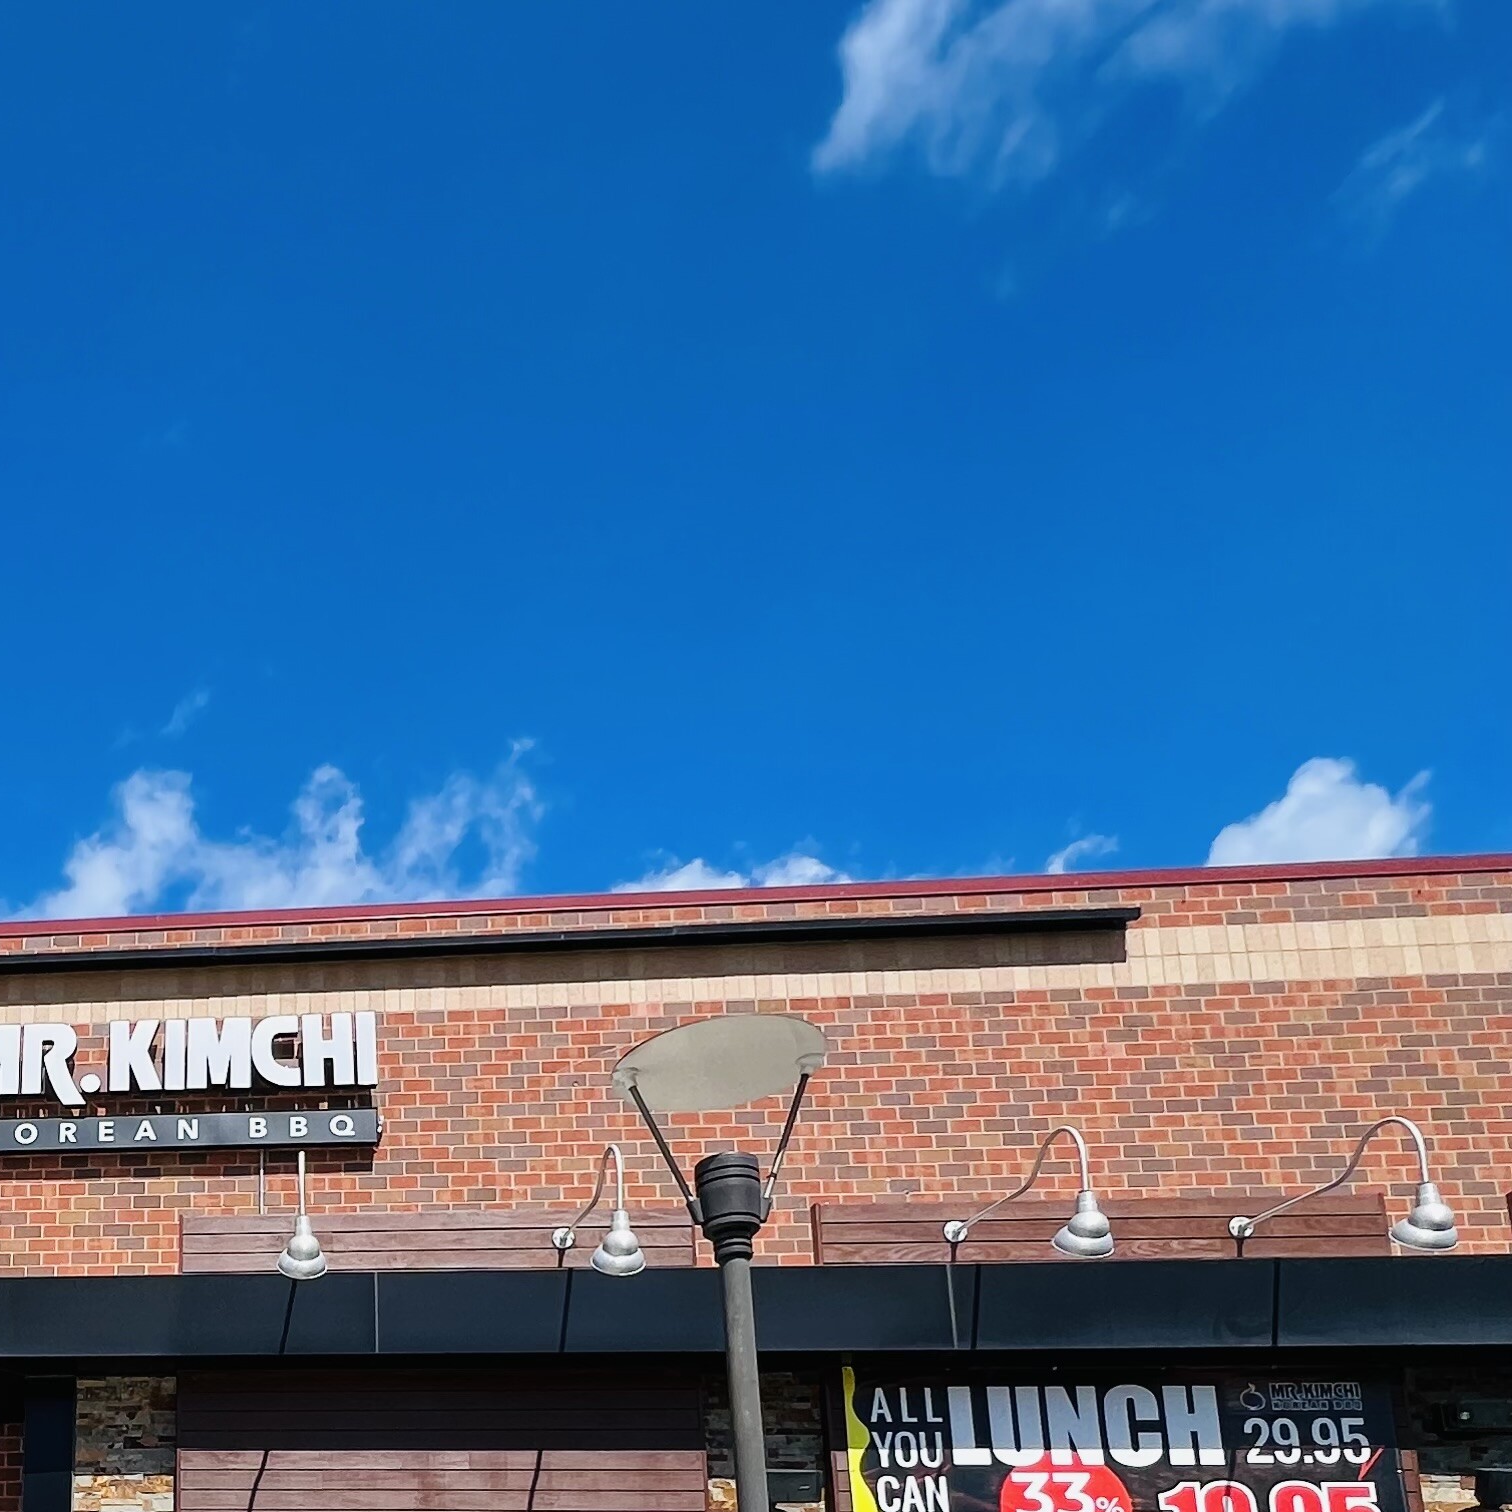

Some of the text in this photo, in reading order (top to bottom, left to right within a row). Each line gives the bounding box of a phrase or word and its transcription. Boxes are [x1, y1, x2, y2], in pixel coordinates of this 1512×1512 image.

[248, 1114, 356, 1139] BBQ
[870, 1387, 943, 1423] ALL
[947, 1385, 1226, 1467] LUNCH
[1243, 1417, 1371, 1464] 29.95
[871, 1431, 944, 1468] YOU
[876, 1475, 950, 1512] CAN
